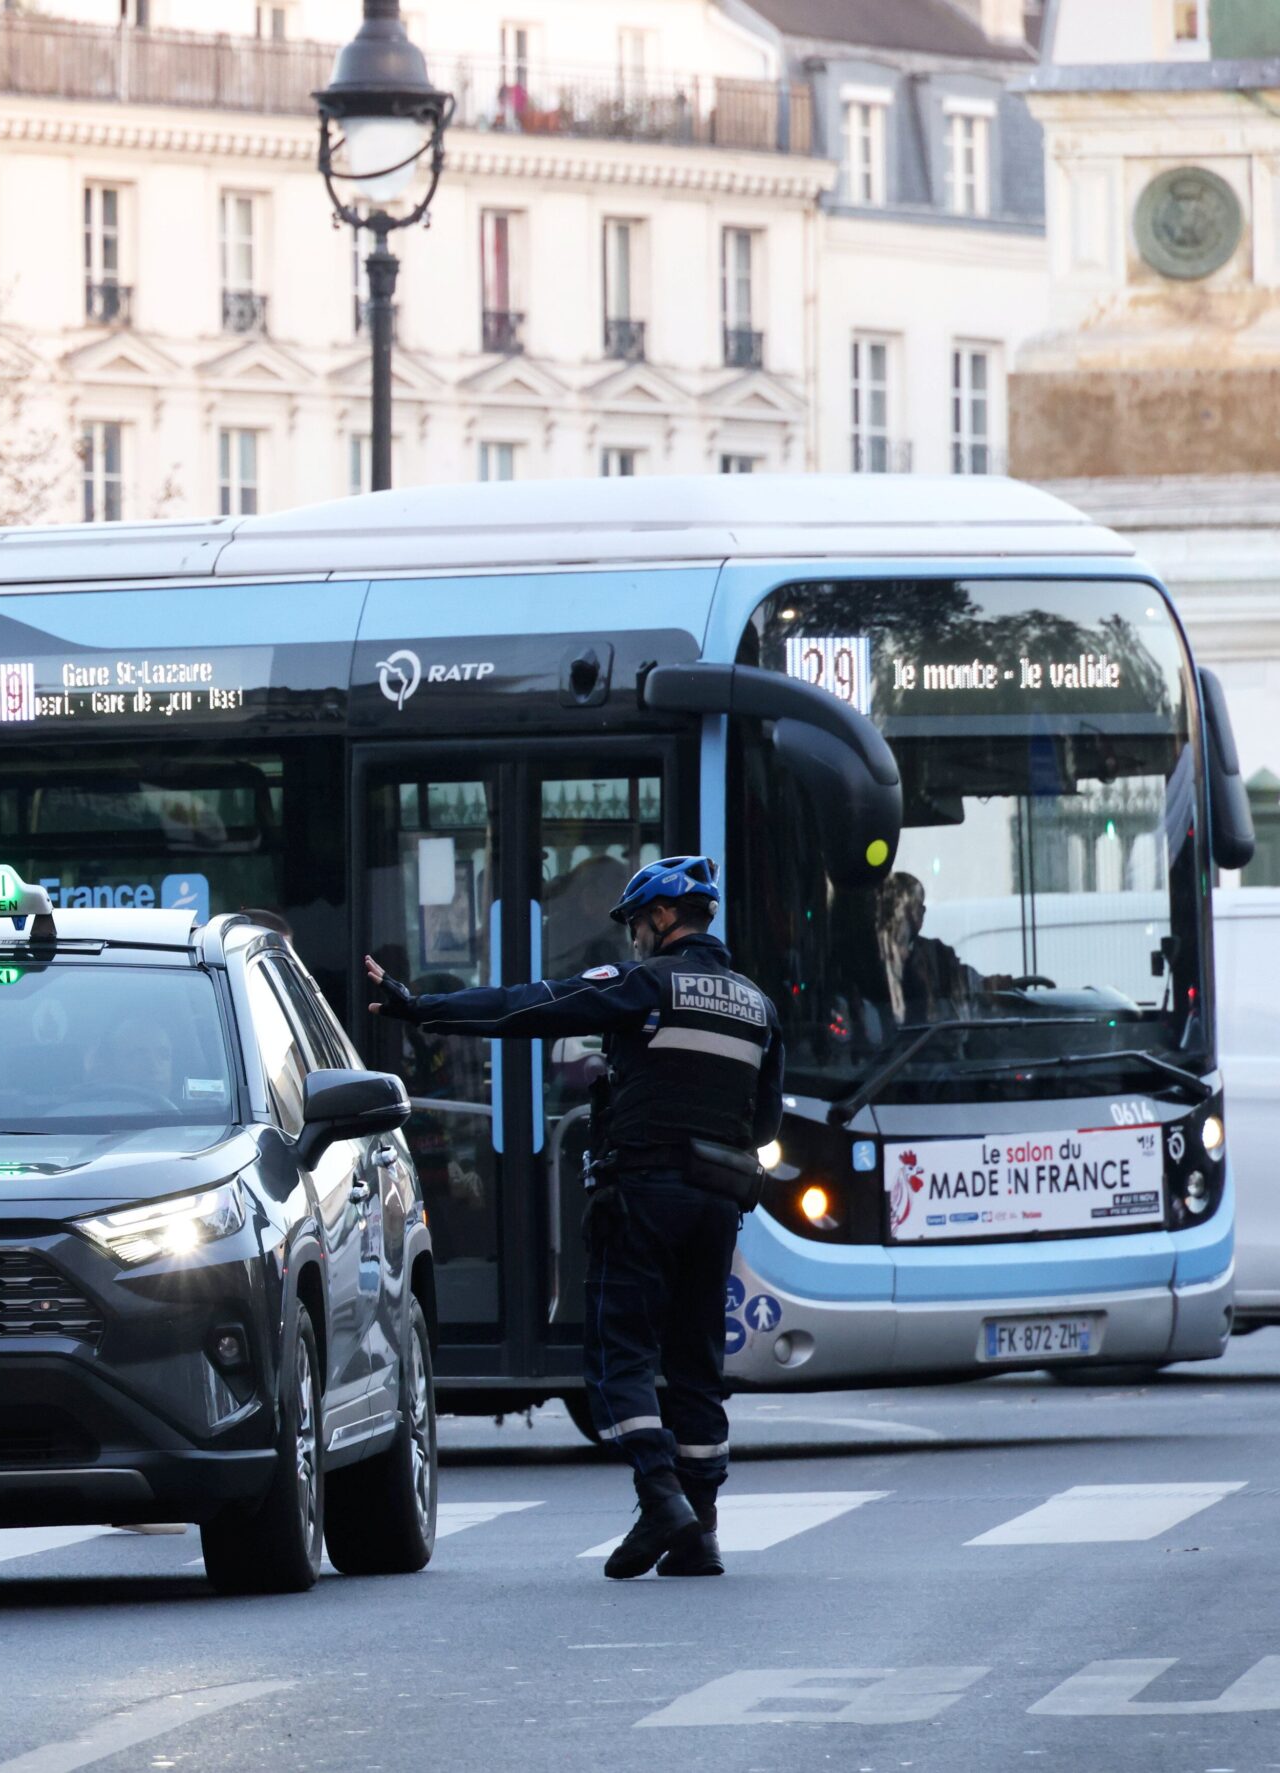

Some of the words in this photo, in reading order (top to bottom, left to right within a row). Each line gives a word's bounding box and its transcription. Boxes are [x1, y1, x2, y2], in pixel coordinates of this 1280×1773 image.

[62, 663, 110, 687] Gare
[427, 662, 495, 682] RATP
[801, 645, 856, 703] 29
[923, 659, 998, 690] monte
[1049, 654, 1120, 689] valide
[39, 877, 156, 909] France
[678, 976, 761, 1010] POLICE
[680, 994, 762, 1023] MUNICIPALE
[1110, 1101, 1155, 1126] 0614
[982, 1143, 1001, 1165] Le
[1007, 1141, 1053, 1164] salon
[1059, 1138, 1082, 1160] du
[929, 1169, 999, 1200] MADE
[1036, 1159, 1131, 1194] FRANCE
[998, 1323, 1077, 1353] FK-872-ZH
